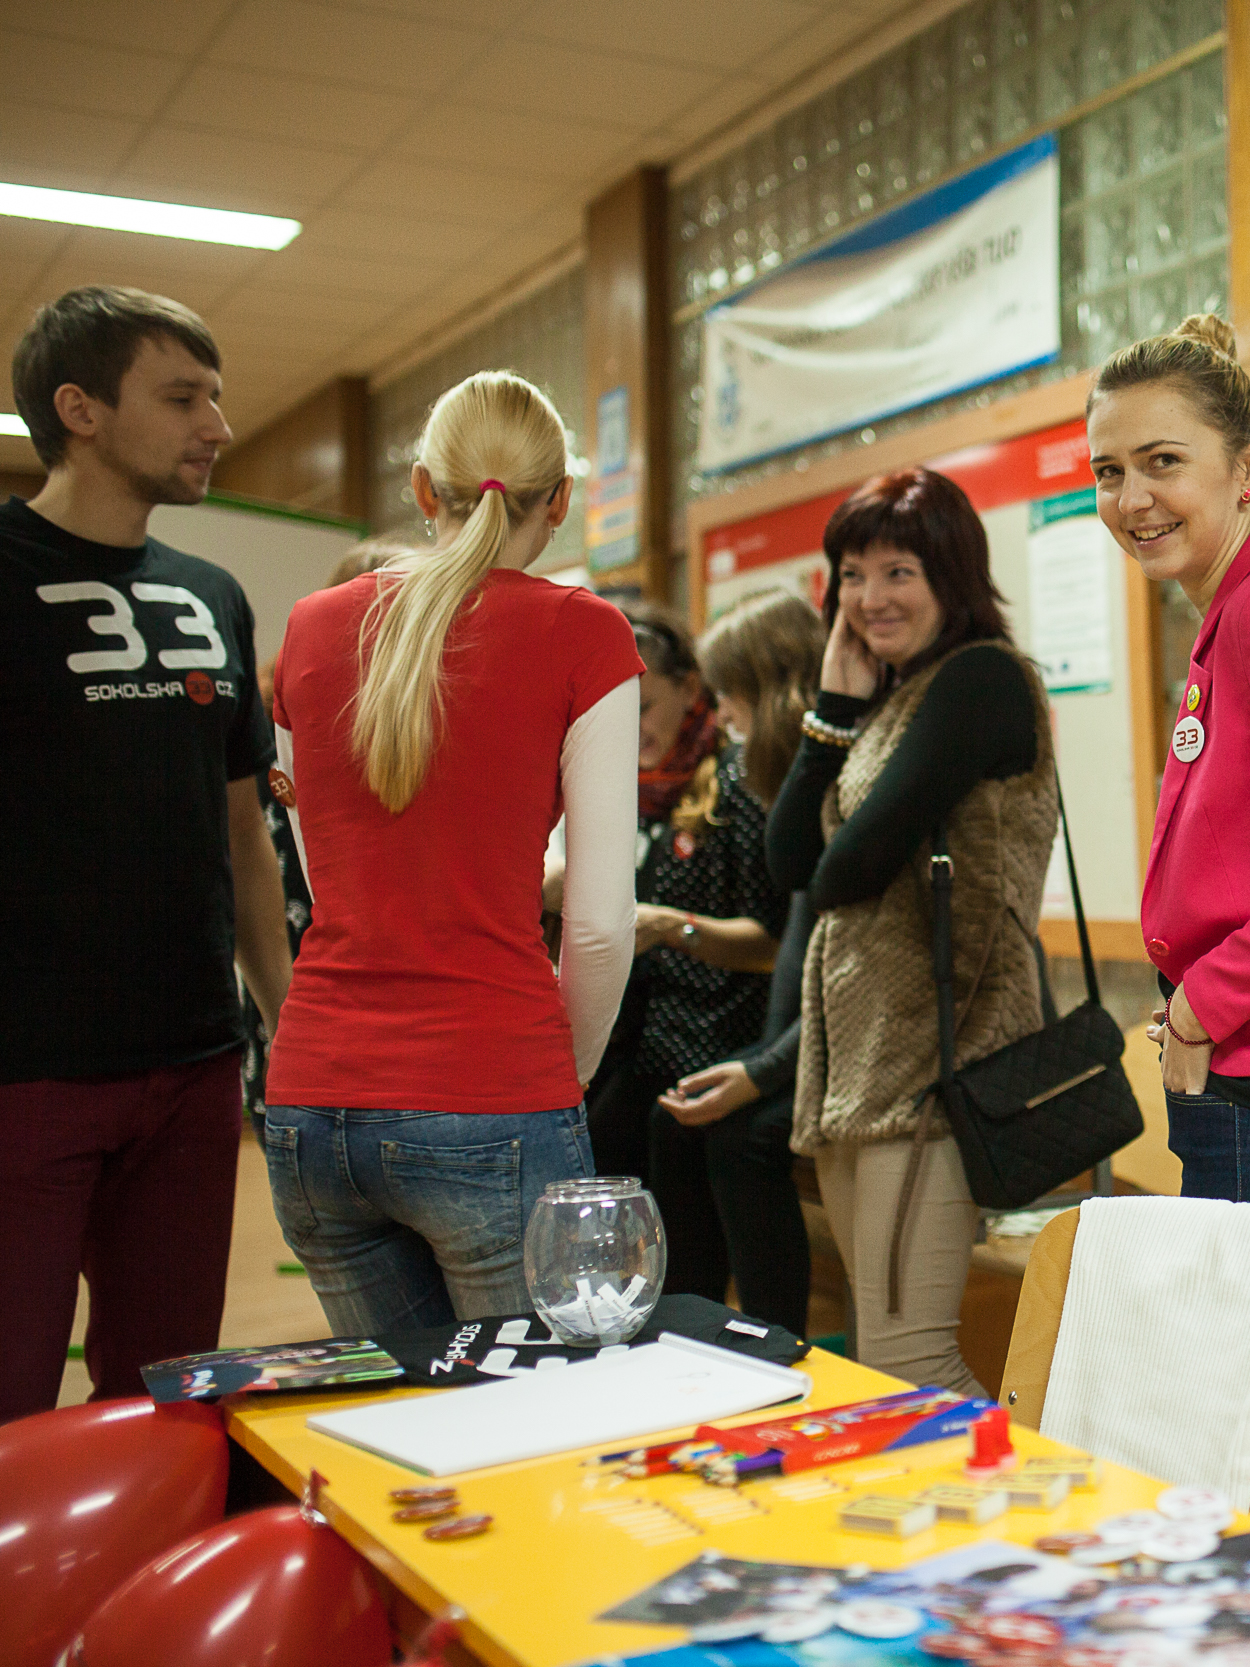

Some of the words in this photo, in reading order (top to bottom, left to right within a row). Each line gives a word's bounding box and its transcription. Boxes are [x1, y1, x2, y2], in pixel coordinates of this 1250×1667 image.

[36, 580, 227, 673] 33
[85, 681, 184, 702] SOKOLSKA
[215, 680, 235, 698] CZ
[1176, 728, 1199, 748] 33
[270, 777, 289, 796] 33
